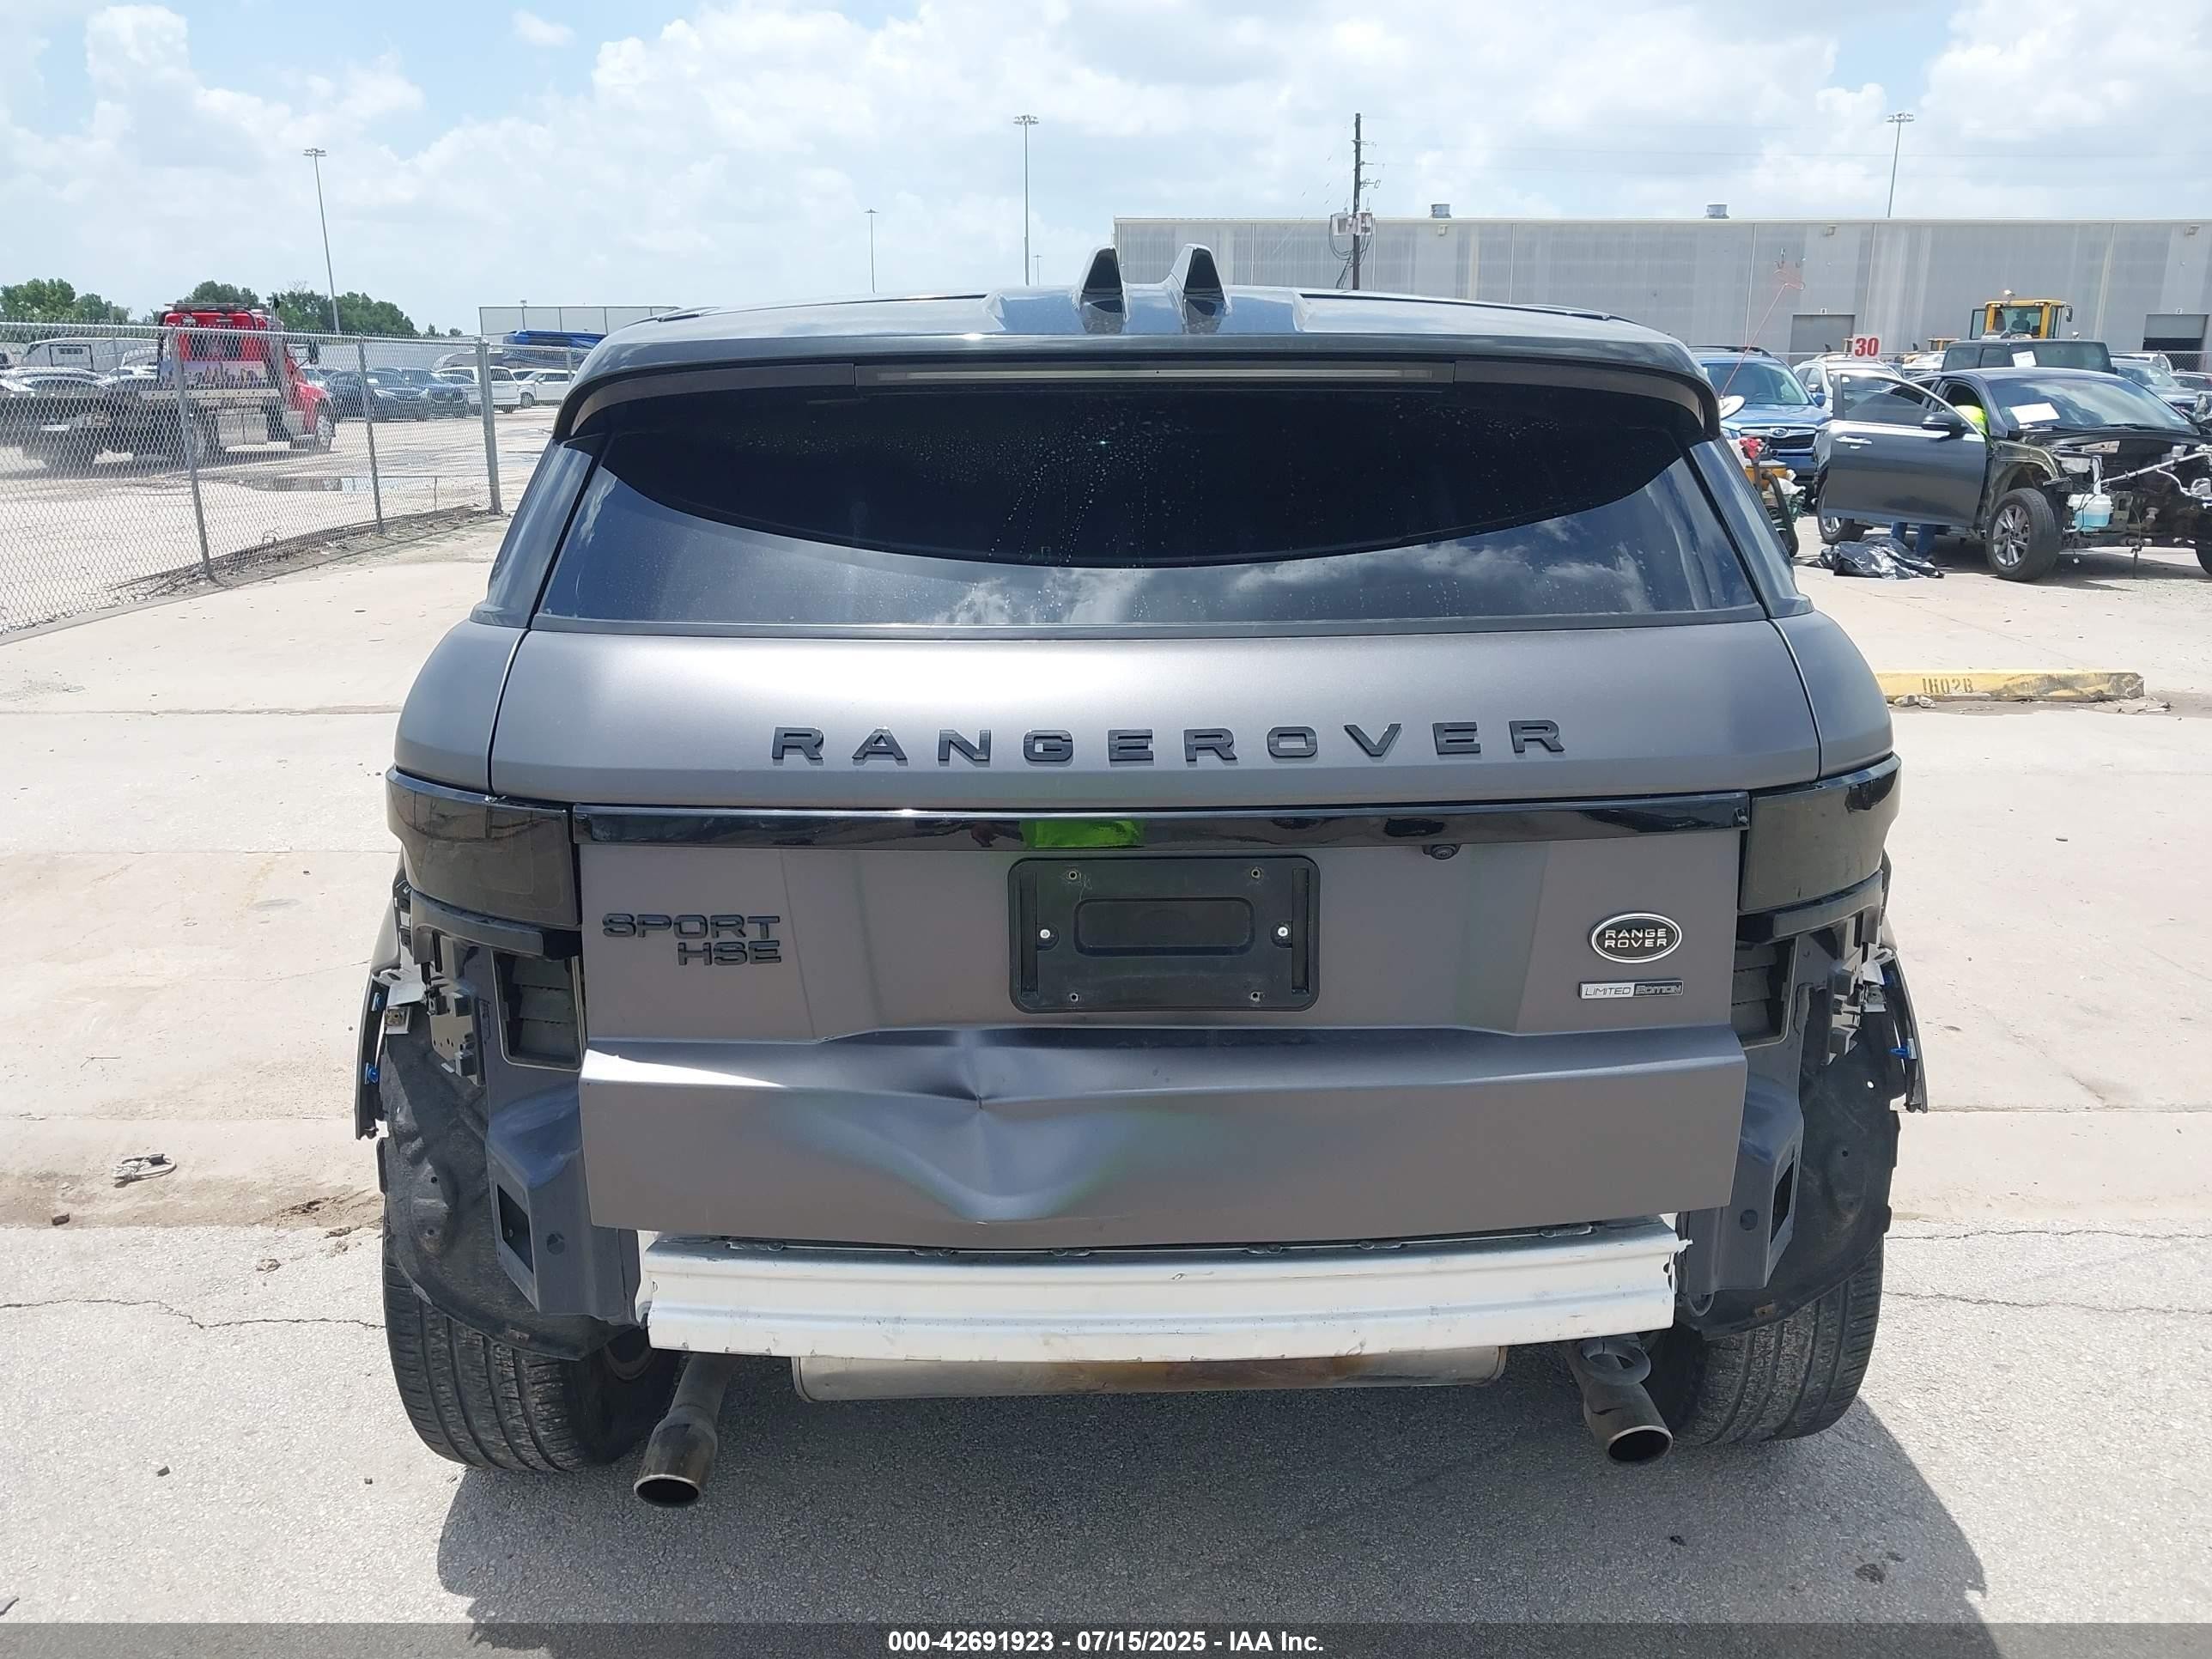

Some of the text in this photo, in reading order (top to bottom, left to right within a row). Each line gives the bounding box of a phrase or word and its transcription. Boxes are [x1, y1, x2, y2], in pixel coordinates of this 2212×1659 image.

[1855, 337, 1879, 356] 30
[602, 913, 781, 939] SPORT
[1605, 928, 1668, 939] RANGE
[1604, 939, 1668, 948] ROVER
[678, 940, 782, 966] HSE
[1584, 987, 1632, 996] LIMITED
